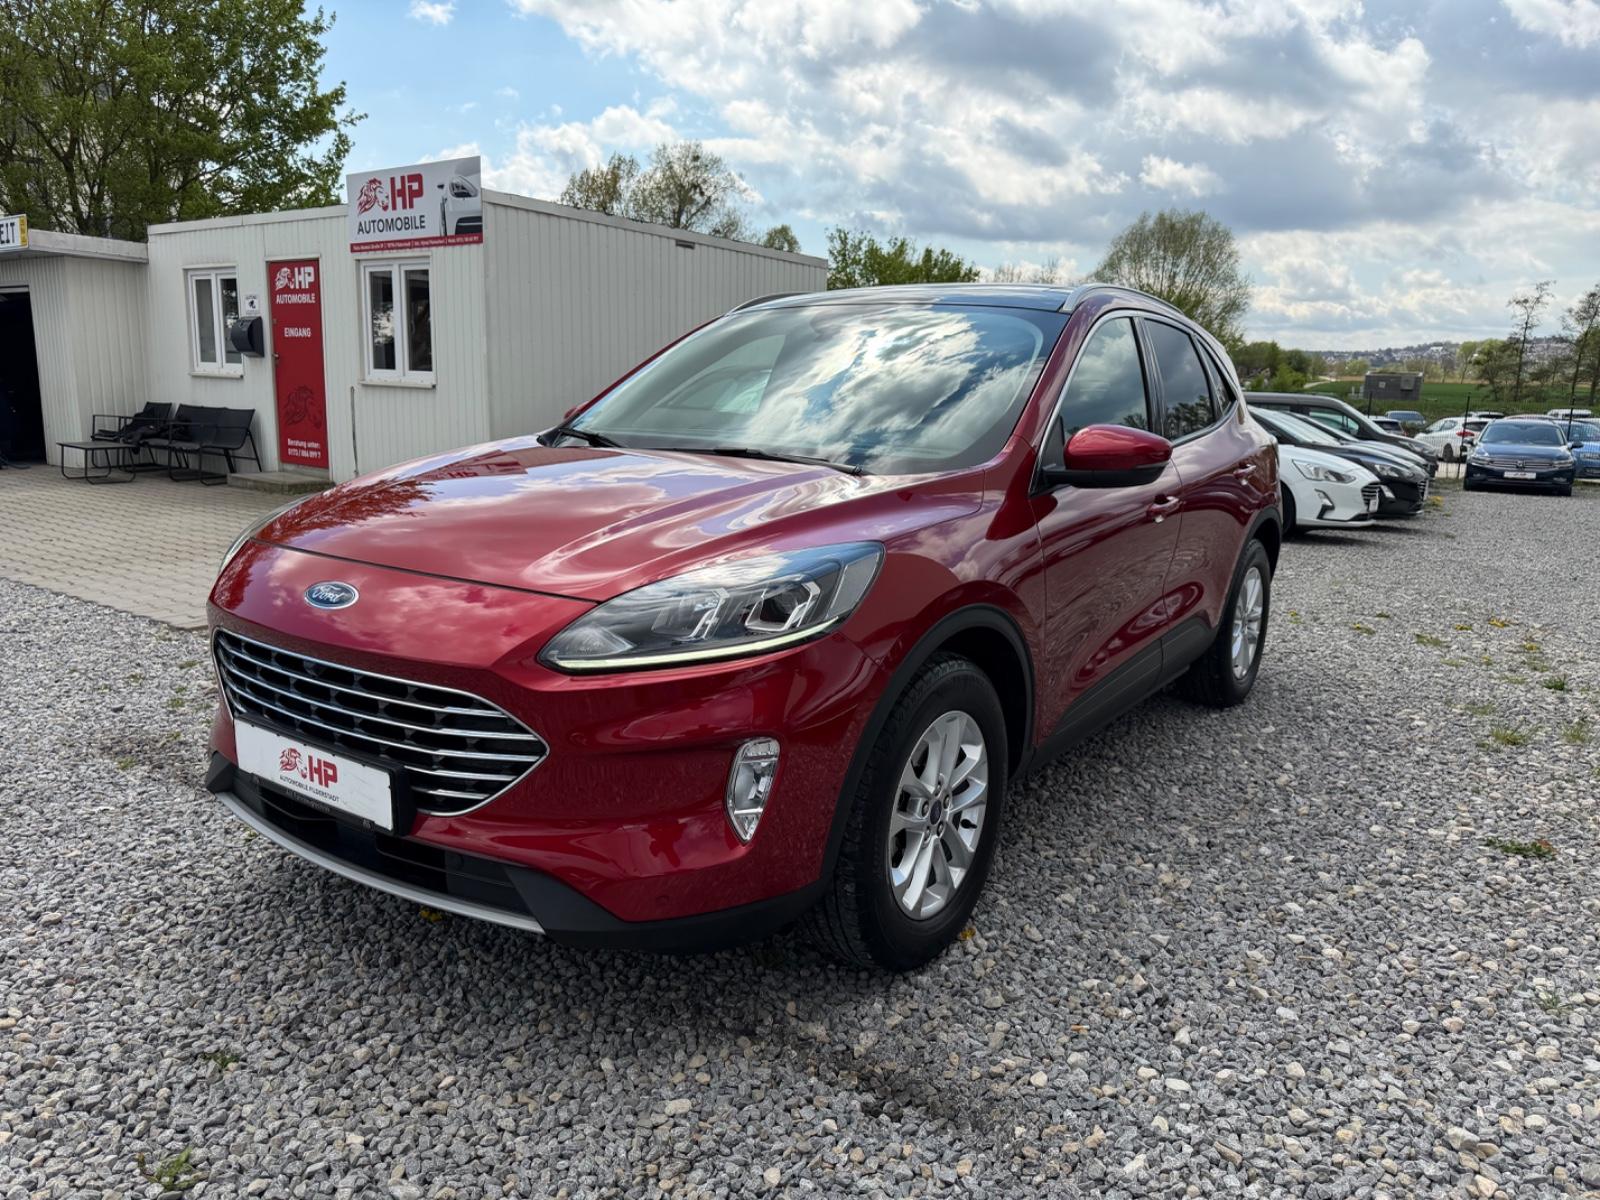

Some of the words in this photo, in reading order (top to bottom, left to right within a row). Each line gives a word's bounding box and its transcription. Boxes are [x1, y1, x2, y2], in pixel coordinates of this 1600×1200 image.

[390, 173, 424, 211] HP
[357, 214, 426, 235] AUTOMOBILE
[294, 266, 315, 289] HP
[276, 293, 316, 304] AUTOMOBILE
[284, 327, 311, 338] EINGANG
[311, 585, 348, 603] Ford
[308, 755, 338, 788] HP
